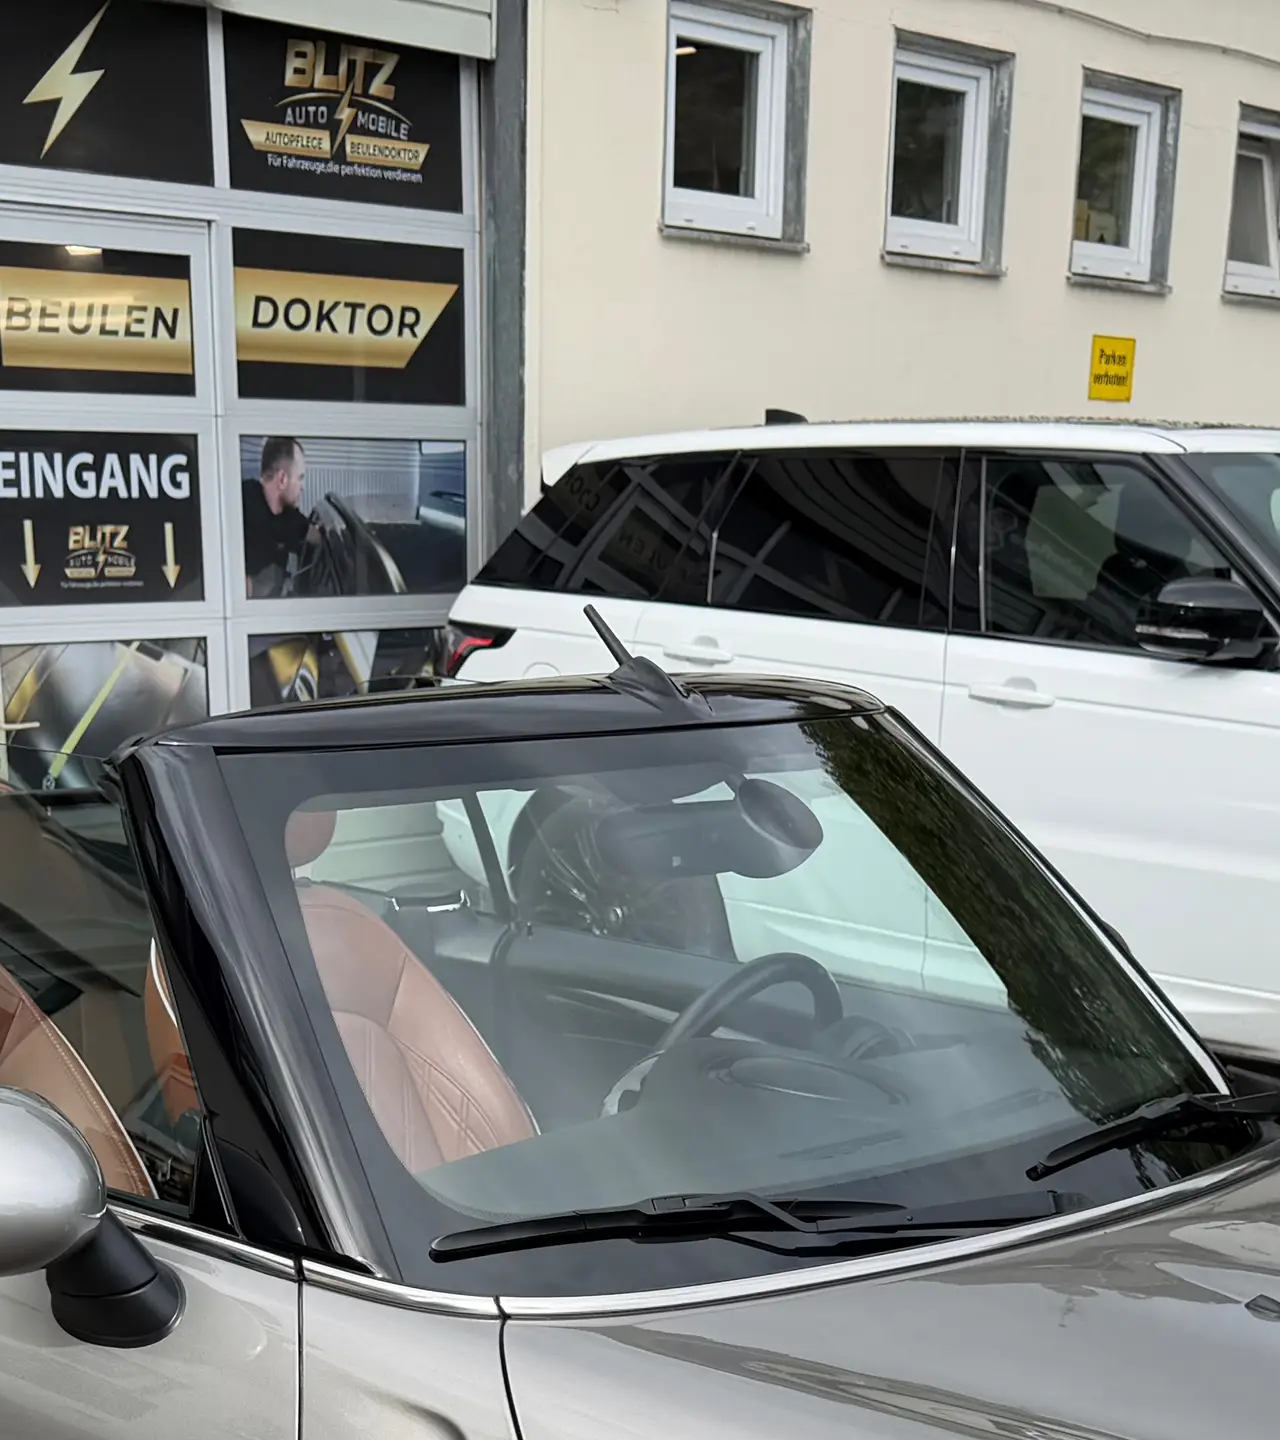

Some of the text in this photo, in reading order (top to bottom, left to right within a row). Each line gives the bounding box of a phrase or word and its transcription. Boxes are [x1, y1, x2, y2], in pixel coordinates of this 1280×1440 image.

[284, 38, 400, 100] BLITZ
[285, 106, 410, 141] AUTO MOBILE
[264, 131, 324, 151] AUTOPFLEGE
[350, 141, 420, 162] BEULENDOKTOR
[267, 153, 282, 167] Für
[4, 295, 421, 340] BEULEN DOKTOR
[68, 525, 130, 550] BLITZ
